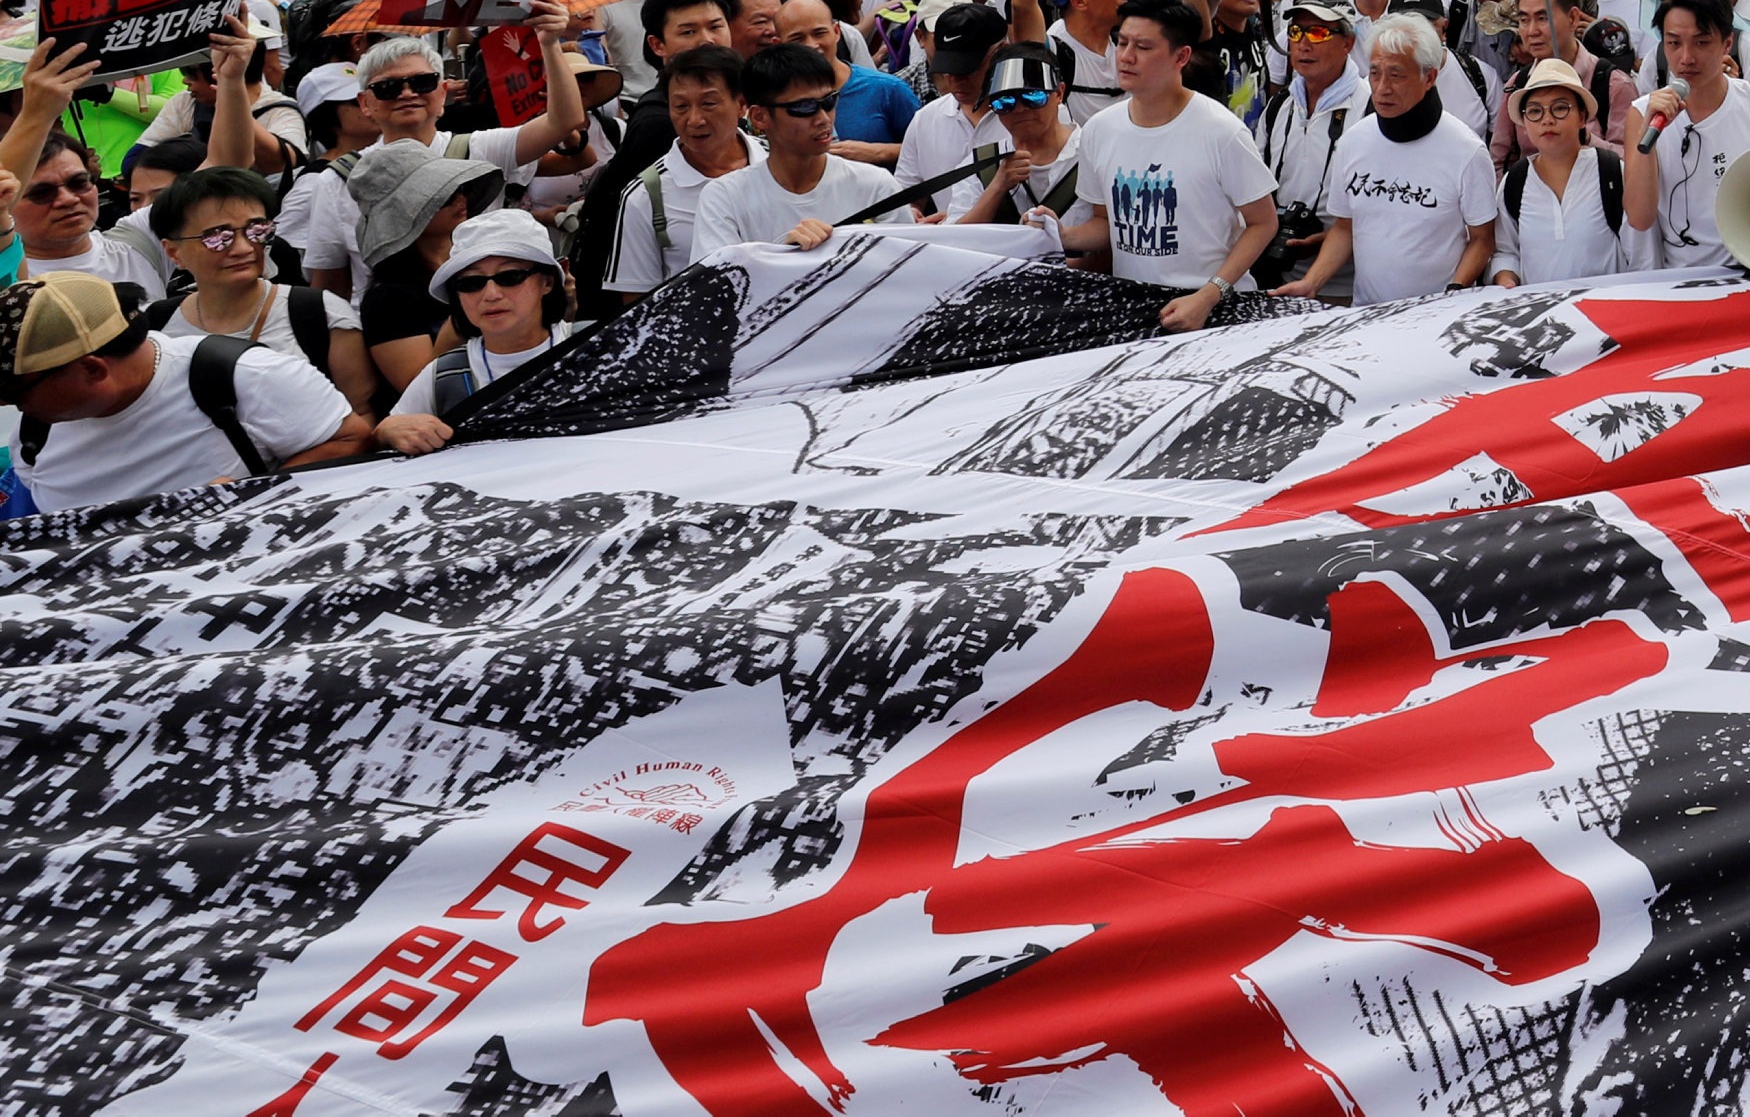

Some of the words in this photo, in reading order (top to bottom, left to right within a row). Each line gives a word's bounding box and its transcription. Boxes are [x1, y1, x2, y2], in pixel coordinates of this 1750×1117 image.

[504, 71, 528, 97] No
[1114, 221, 1178, 249] TIME
[1136, 247, 1153, 256] OUR
[1155, 247, 1178, 257] SIDE
[579, 770, 628, 797] Civil
[636, 761, 703, 776] Human
[707, 766, 737, 795] Rights
